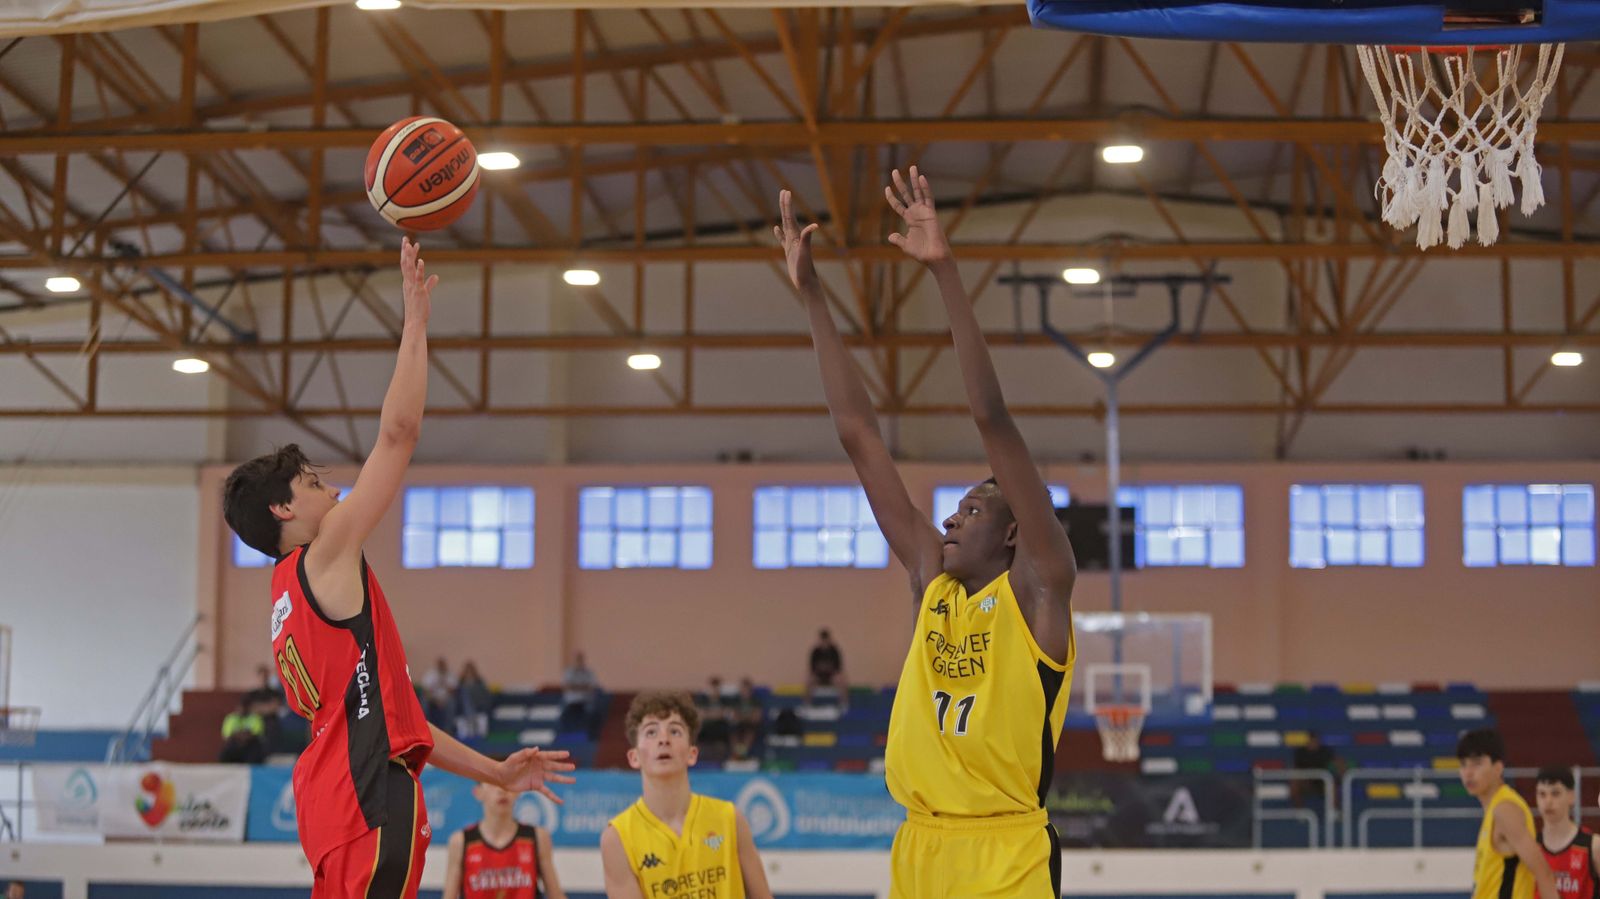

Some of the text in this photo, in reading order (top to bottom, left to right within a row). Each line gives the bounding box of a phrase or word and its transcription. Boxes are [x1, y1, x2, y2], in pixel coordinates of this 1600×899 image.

[418, 148, 470, 193] molten
[932, 690, 976, 736] 11
[651, 866, 727, 898] FOREVER
